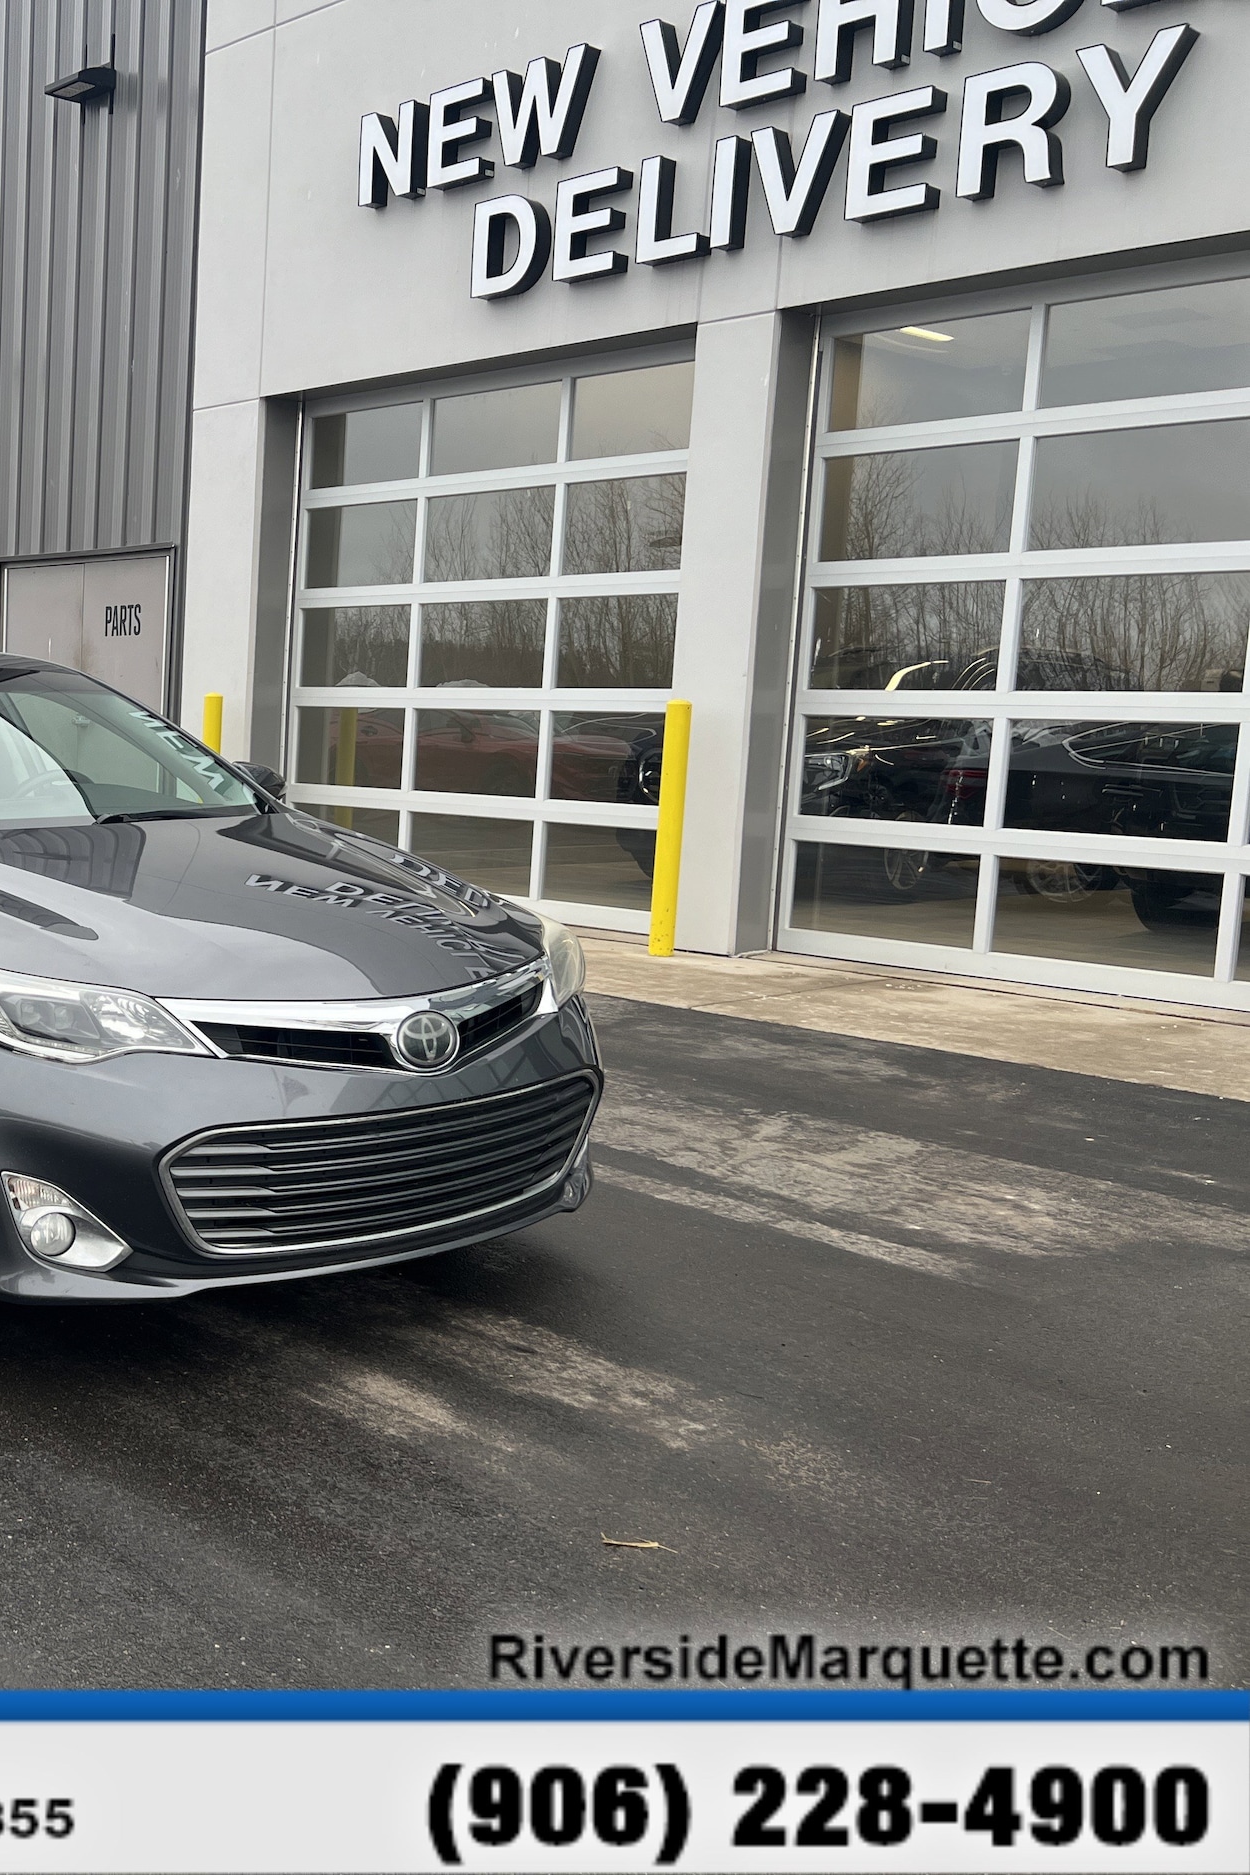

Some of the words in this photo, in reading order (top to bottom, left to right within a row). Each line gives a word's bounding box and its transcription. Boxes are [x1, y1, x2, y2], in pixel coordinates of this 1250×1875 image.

[358, 43, 601, 208] NEW
[470, 23, 1200, 300] DELIVERY
[105, 604, 141, 637] PARTS
